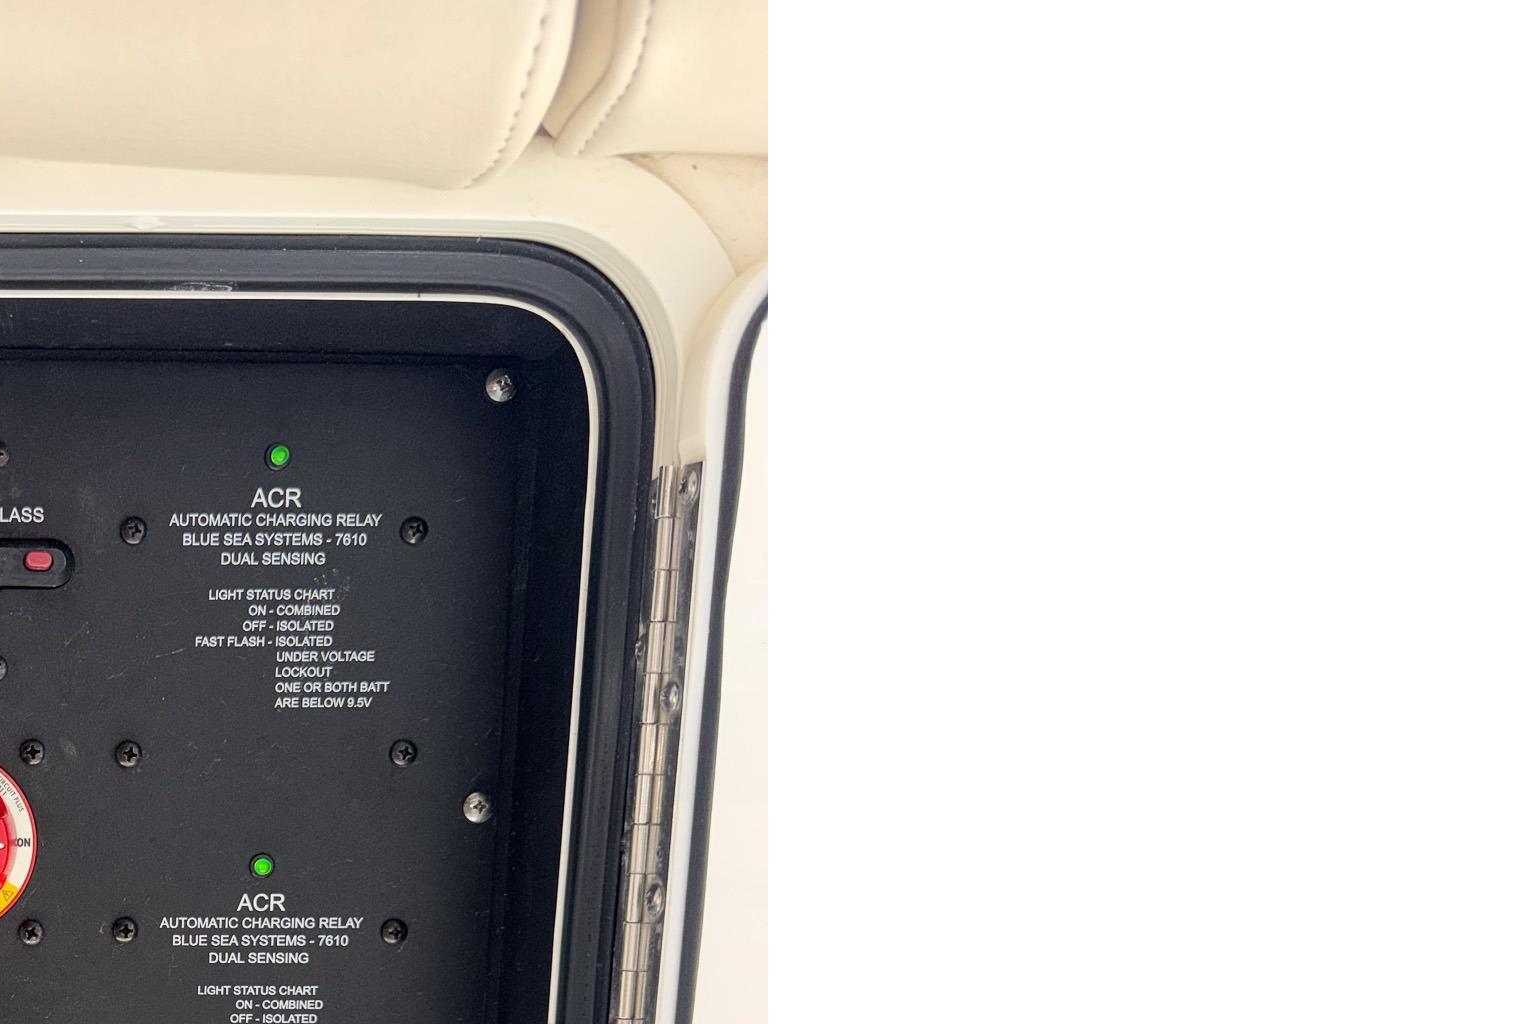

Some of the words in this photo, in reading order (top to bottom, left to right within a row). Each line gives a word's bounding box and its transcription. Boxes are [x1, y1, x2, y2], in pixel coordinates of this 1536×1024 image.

[250, 487, 302, 509] ACR
[168, 512, 253, 527] AUTOMATIC
[255, 513, 333, 527] CHARGING
[336, 513, 383, 527] RELAY
[182, 532, 220, 547] BLUE
[223, 532, 253, 546] SEA
[254, 531, 323, 546] SYSTEMS
[334, 532, 368, 547] 7610
[220, 551, 259, 566] DUAL
[261, 551, 326, 566] SENSING
[208, 588, 245, 601] LIGHT
[245, 588, 292, 601] STATUS
[293, 588, 336, 602] CHART
[248, 604, 267, 617] ON
[276, 604, 341, 616] COMBINED
[242, 619, 267, 632] OFF
[276, 619, 335, 632] ISOLATED
[194, 635, 226, 648] FAST
[227, 635, 266, 648] FLASH
[275, 635, 333, 648] ISOLATED
[276, 650, 319, 663] UNDER
[320, 650, 376, 663] VOLTAGE
[275, 665, 333, 678] LOCKOUT
[274, 681, 302, 694] ONE
[303, 681, 322, 693] OR
[324, 681, 358, 693] BOTH
[359, 680, 390, 693] BATT
[274, 696, 300, 709] ARE
[301, 696, 346, 708] BELOW
[346, 696, 373, 708] 9.5V
[13, 796, 25, 814] PLUS
[16, 837, 32, 849] ON
[236, 893, 286, 912] ACR
[159, 916, 239, 929] AUTOMATIC
[241, 916, 316, 929] CHARGING
[318, 916, 364, 929] RELAY
[172, 934, 208, 947] BLUE
[210, 934, 239, 947] SEA
[240, 934, 307, 947] SYSTEMS
[317, 934, 349, 947] 7610
[208, 951, 246, 964] DUAL
[247, 951, 310, 964] SENSING
[197, 985, 232, 996] LIGHT
[233, 985, 277, 996] STATUS
[278, 985, 319, 996] CHART
[235, 999, 253, 1010] ON
[261, 999, 324, 1010] COMBINED
[229, 1013, 254, 1024] OFF
[262, 1013, 318, 1024] ISOLATED
